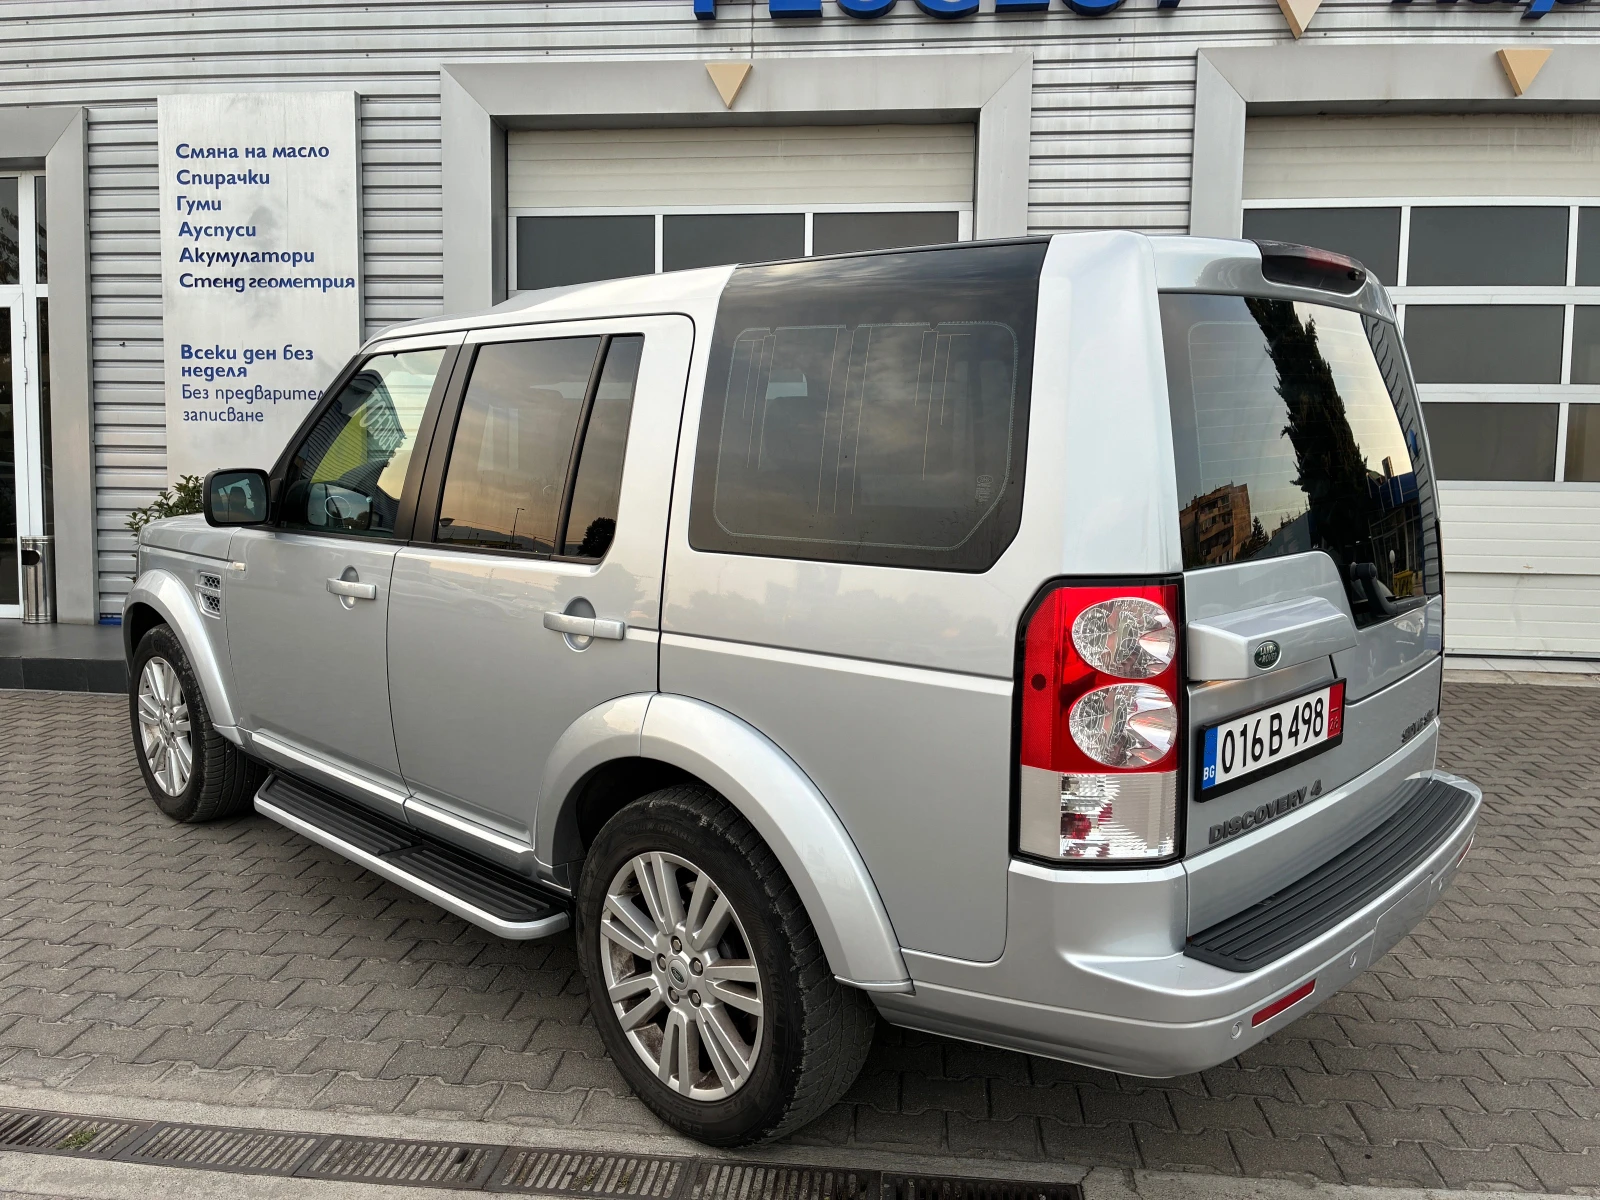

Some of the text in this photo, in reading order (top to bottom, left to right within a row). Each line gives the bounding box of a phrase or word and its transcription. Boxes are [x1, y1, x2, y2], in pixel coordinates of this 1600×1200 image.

[175, 143, 330, 159] Смяна на масло
[176, 168, 270, 190] Спирачки
[176, 195, 222, 216] Гуми
[178, 221, 257, 242] Ауспуси
[179, 247, 315, 268] Акумулатори
[179, 272, 356, 293] Стенд геометрия
[180, 344, 314, 365] Всеки ден без
[181, 366, 248, 382] неделя
[181, 383, 209, 400] Без
[183, 406, 264, 422] записване
[1203, 765, 1215, 780] BG
[1208, 779, 1323, 844] DISCOVERY 4
